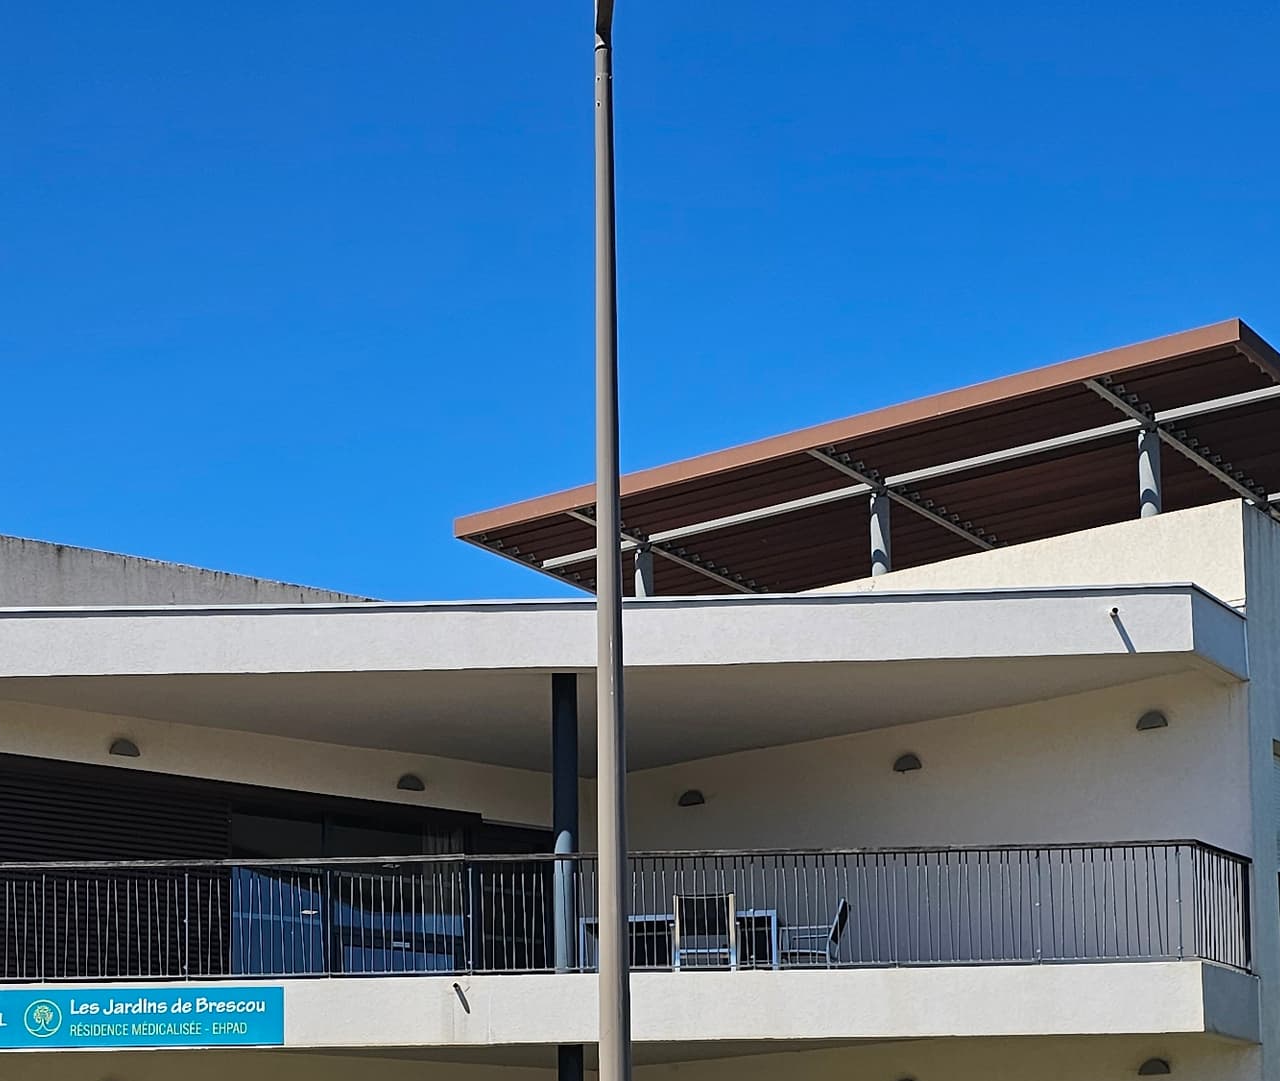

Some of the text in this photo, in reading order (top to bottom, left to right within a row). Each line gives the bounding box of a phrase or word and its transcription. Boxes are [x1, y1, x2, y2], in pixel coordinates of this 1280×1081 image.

[70, 997, 266, 1015] Les Jardins de Brescou
[70, 1021, 128, 1037] RÉSIDENCE
[131, 1020, 202, 1036] MÉDICALISÉE
[212, 1022, 248, 1035] EHPAD
